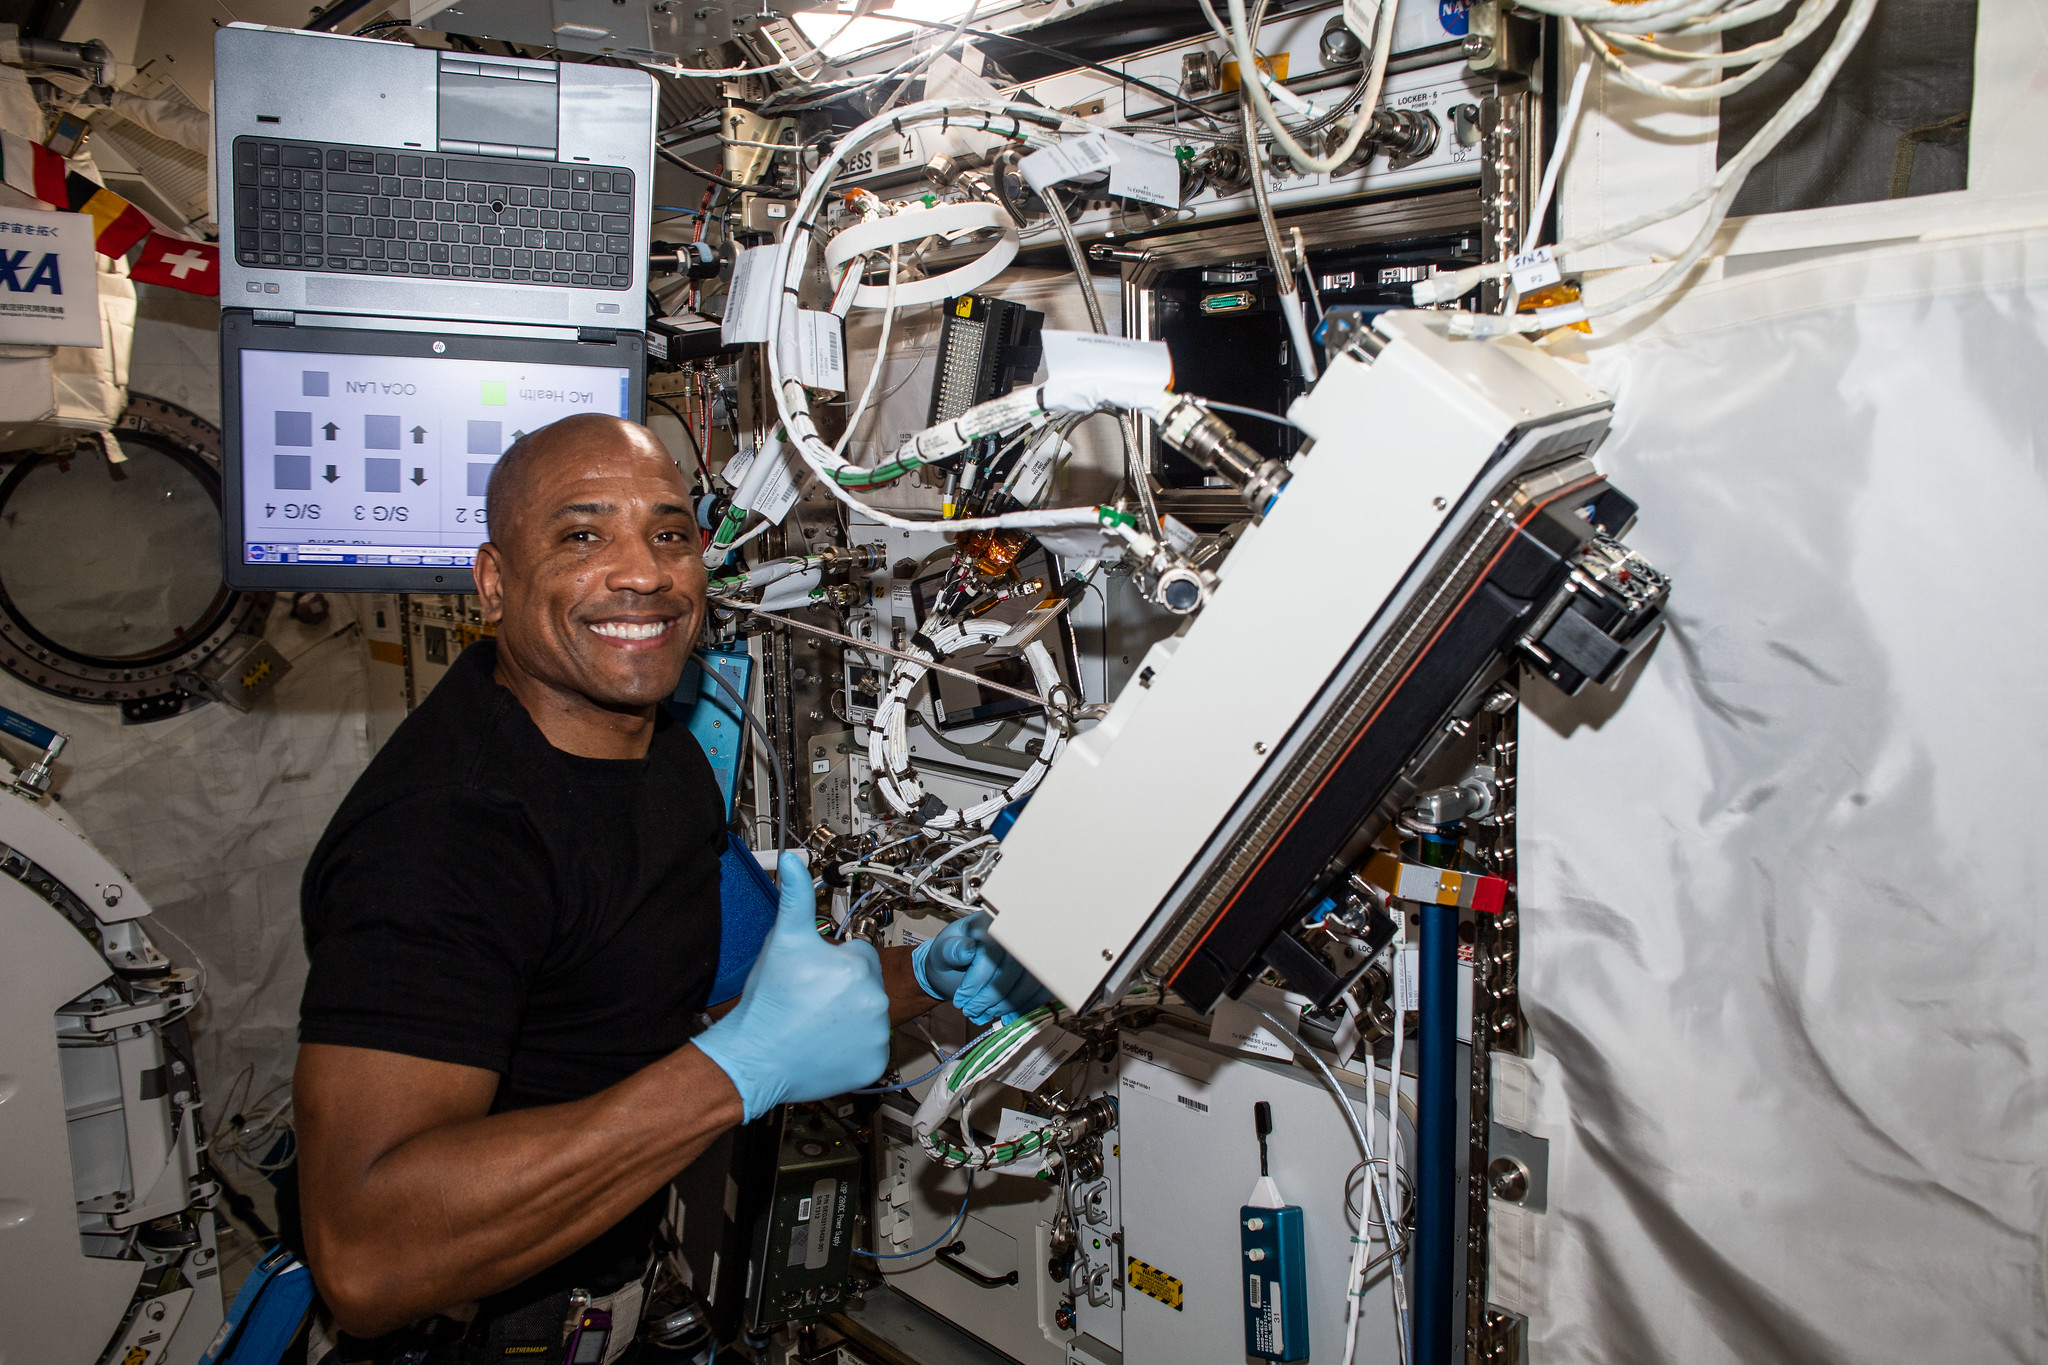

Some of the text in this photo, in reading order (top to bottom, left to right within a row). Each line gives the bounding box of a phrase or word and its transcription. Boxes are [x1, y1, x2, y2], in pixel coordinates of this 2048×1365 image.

[1398, 94, 1427, 105] LOCKER
[903, 135, 913, 159] 4
[1454, 154, 1466, 162] D2
[1133, 188, 1151, 196] EXPRESS
[1272, 183, 1283, 191] B2
[0, 222, 58, 237] 宇宙を拓く
[0, 249, 62, 295] XA
[346, 380, 417, 396] OCA LAN
[519, 388, 594, 404] IAC Health
[265, 503, 321, 519] S/G 4
[354, 505, 409, 522] S/G 3
[456, 508, 467, 522] 2
[1123, 1040, 1153, 1061] Iceberg
[836, 1214, 844, 1229] Power
[832, 1231, 842, 1246] Supply
[1142, 1268, 1168, 1285] WARNING
[1274, 1313, 1280, 1323] 31
